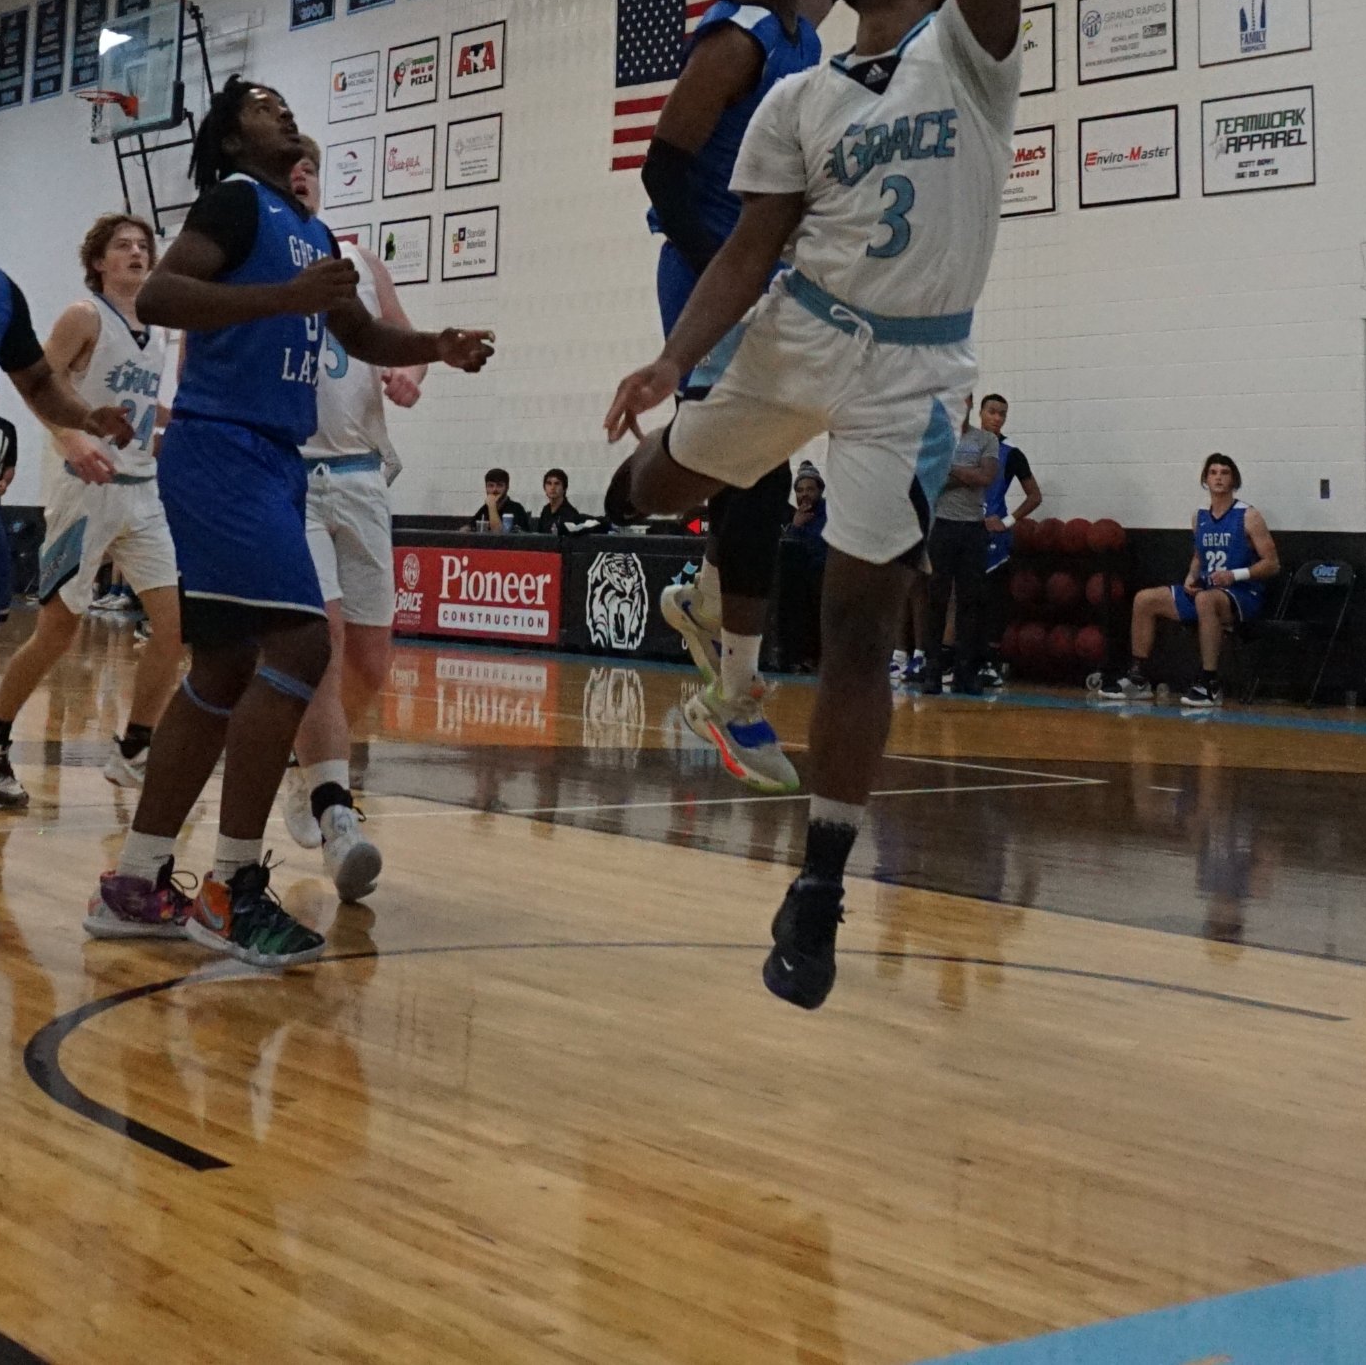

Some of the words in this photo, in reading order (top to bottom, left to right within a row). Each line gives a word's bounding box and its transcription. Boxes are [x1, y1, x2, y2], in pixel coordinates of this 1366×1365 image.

[411, 74, 433, 87] PIZZA
[1216, 107, 1306, 135] TEAMWORK
[823, 108, 956, 186] GRACE
[1225, 129, 1307, 154] APPAREL
[867, 175, 915, 258] 3
[1202, 533, 1231, 546] GREAT
[1206, 551, 1227, 572] 22
[438, 555, 551, 605] Pioneer
[442, 610, 545, 628] CONSTRUCTION
